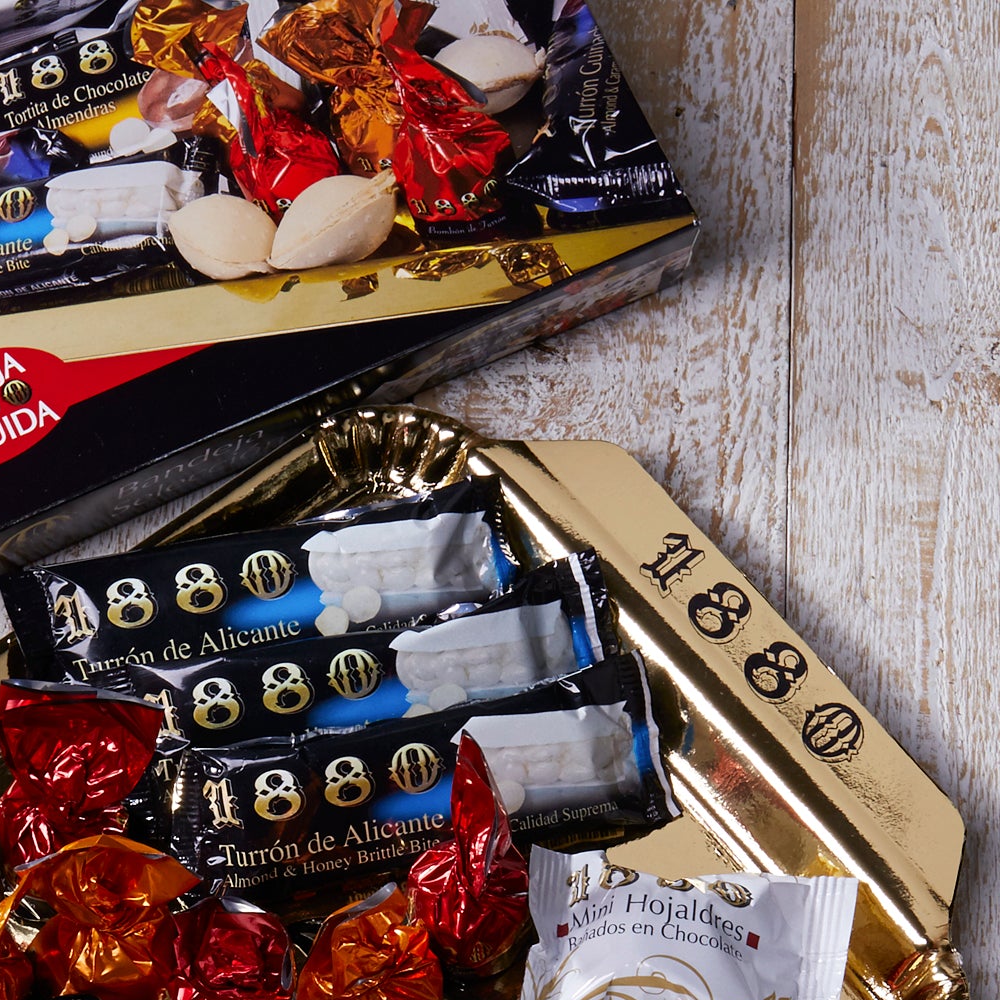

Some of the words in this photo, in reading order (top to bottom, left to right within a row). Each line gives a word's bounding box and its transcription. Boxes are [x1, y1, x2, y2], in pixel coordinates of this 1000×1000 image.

[4, 103, 49, 129] Tortita
[52, 93, 70, 111] de
[73, 69, 151, 102] Chocolate
[36, 101, 117, 130] Almendras
[6, 256, 31, 273] Bite
[54, 550, 299, 645] 1880
[163, 638, 192, 662] de
[199, 619, 301, 656] Alicante
[639, 533, 865, 763] 1880
[144, 648, 386, 738] 1880
[202, 742, 446, 830] 1880
[218, 840, 300, 868] Turrón
[307, 831, 336, 851] de
[343, 812, 446, 847] Alicante
[509, 812, 559, 833] Calidad
[562, 799, 619, 823] Suprema
[223, 866, 279, 888] Almond
[283, 864, 298, 878] &
[303, 856, 352, 876] Honey
[358, 843, 405, 865] Brittle
[409, 836, 441, 854] Bite
[570, 895, 615, 933] Mini
[626, 893, 744, 942] Hojaldres
[631, 921, 654, 936] en
[661, 922, 744, 962] Chocolate
